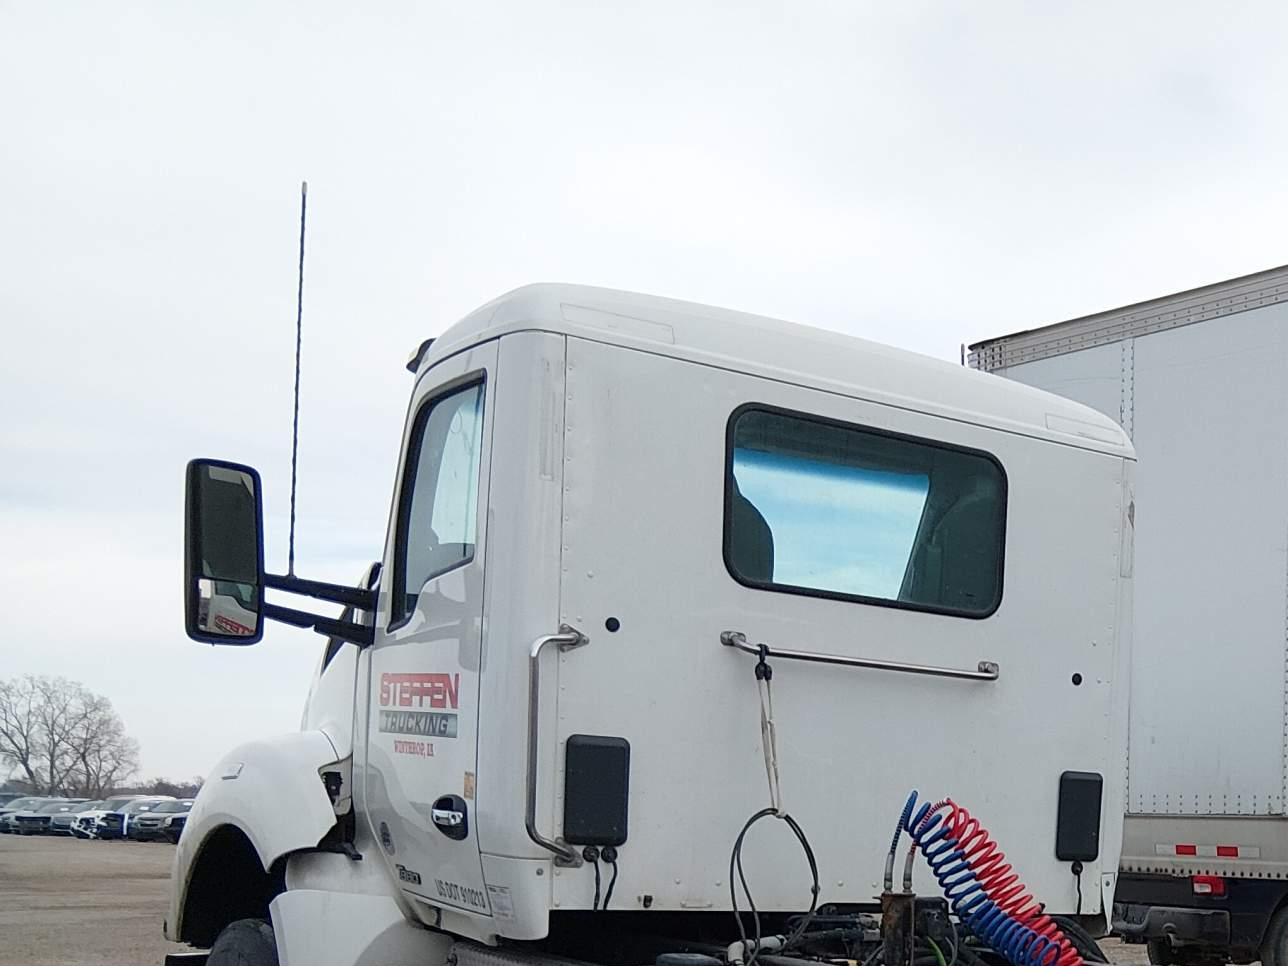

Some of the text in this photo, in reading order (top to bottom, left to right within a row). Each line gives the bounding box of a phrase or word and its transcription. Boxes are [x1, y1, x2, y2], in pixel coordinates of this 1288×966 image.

[379, 672, 460, 709] STEFFEN
[384, 713, 450, 736] TRUCKING
[435, 879, 446, 897] US
[445, 881, 460, 901] DOT
[460, 886, 486, 909] 910213
